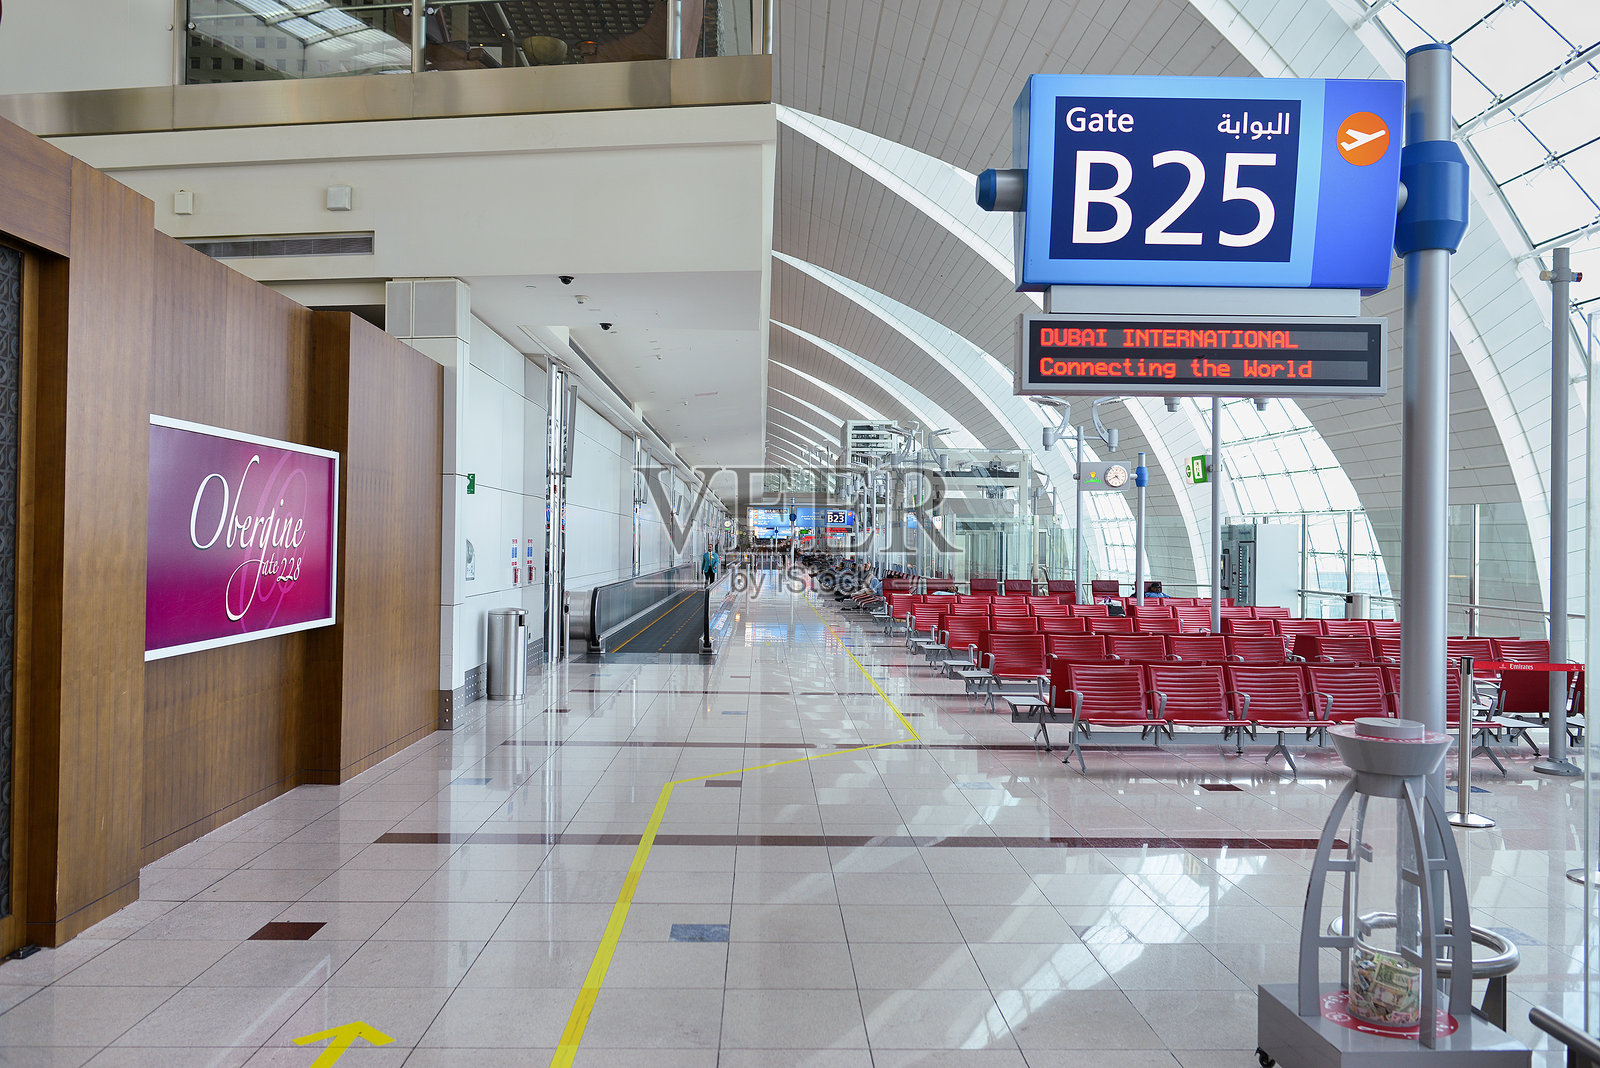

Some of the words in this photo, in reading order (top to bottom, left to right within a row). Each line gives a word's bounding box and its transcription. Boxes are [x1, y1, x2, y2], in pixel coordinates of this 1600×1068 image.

[1065, 106, 1135, 133] Gate
[1216, 111, 1291, 140] البوابة
[1071, 150, 1276, 248] B25
[1040, 328, 1108, 348] DUBAI
[1122, 329, 1299, 349] INTERNATIONAL
[1039, 357, 1177, 379] Connecting
[1190, 358, 1231, 378] the
[1243, 360, 1313, 379] World
[827, 514, 845, 523] B23
[190, 455, 306, 621] Obergine
[276, 557, 302, 582] 228
